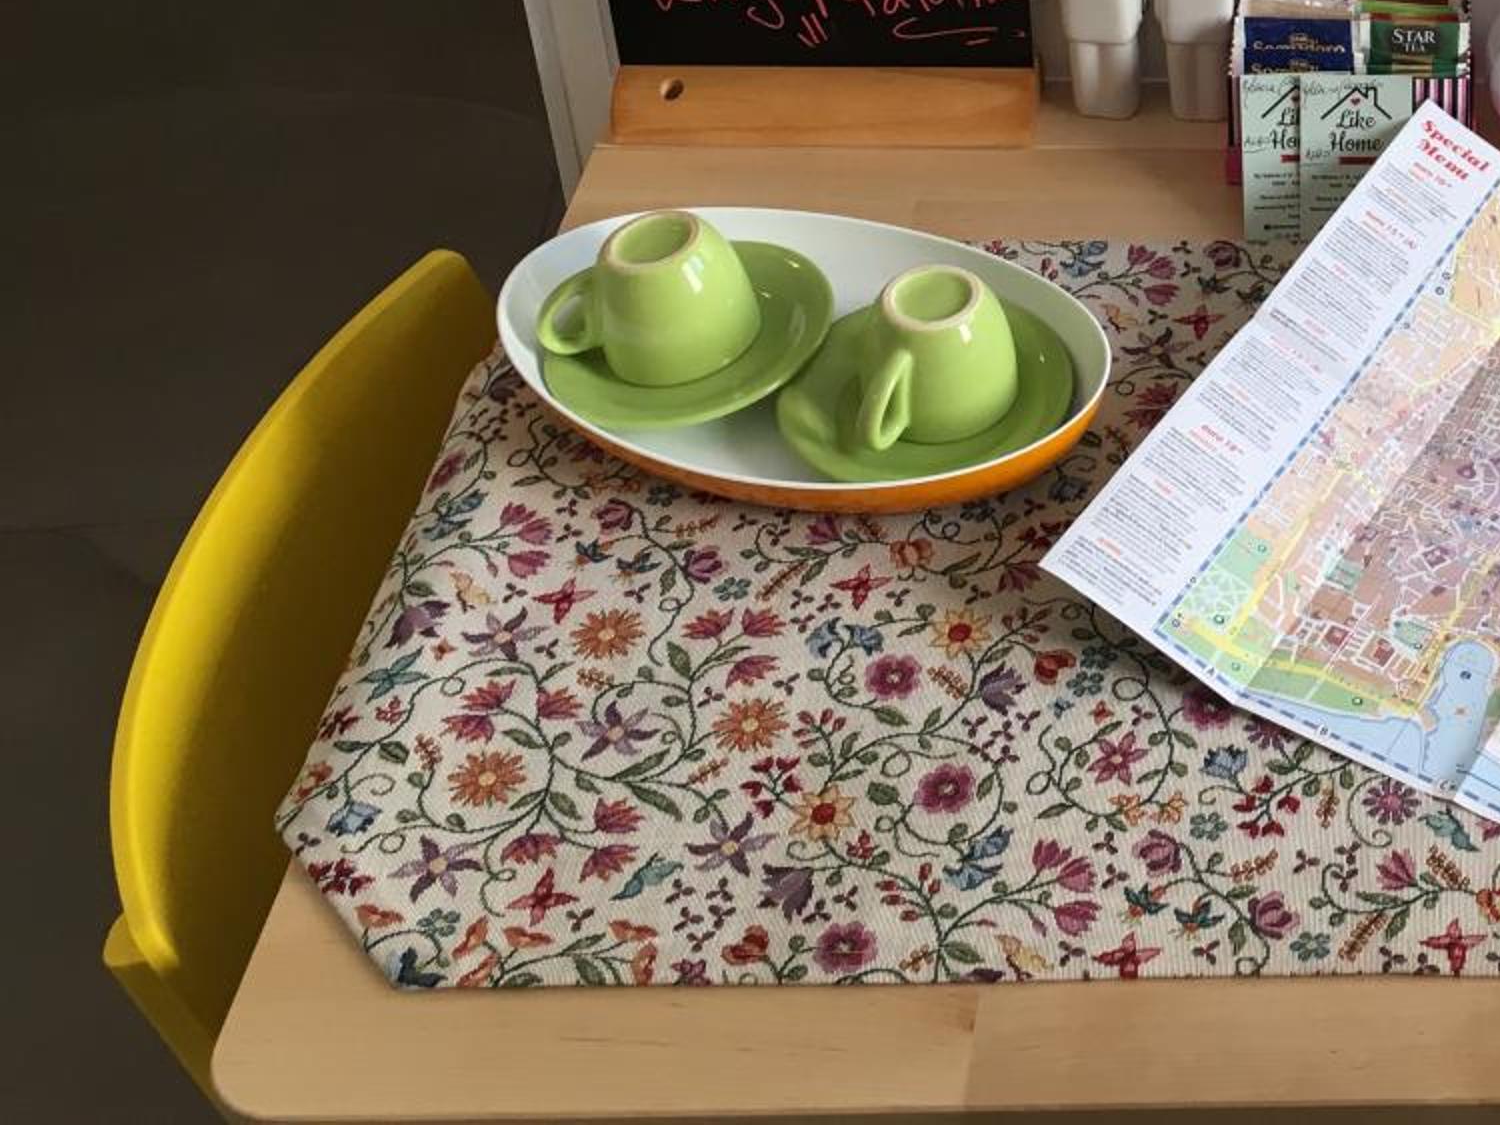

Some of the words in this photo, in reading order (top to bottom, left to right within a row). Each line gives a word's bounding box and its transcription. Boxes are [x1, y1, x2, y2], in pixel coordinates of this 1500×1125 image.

[1392, 28, 1437, 46] STAR
[1335, 109, 1376, 130] Like
[1329, 129, 1384, 153] Home
[1423, 119, 1490, 172] Special
[1418, 138, 1469, 181] Menu
